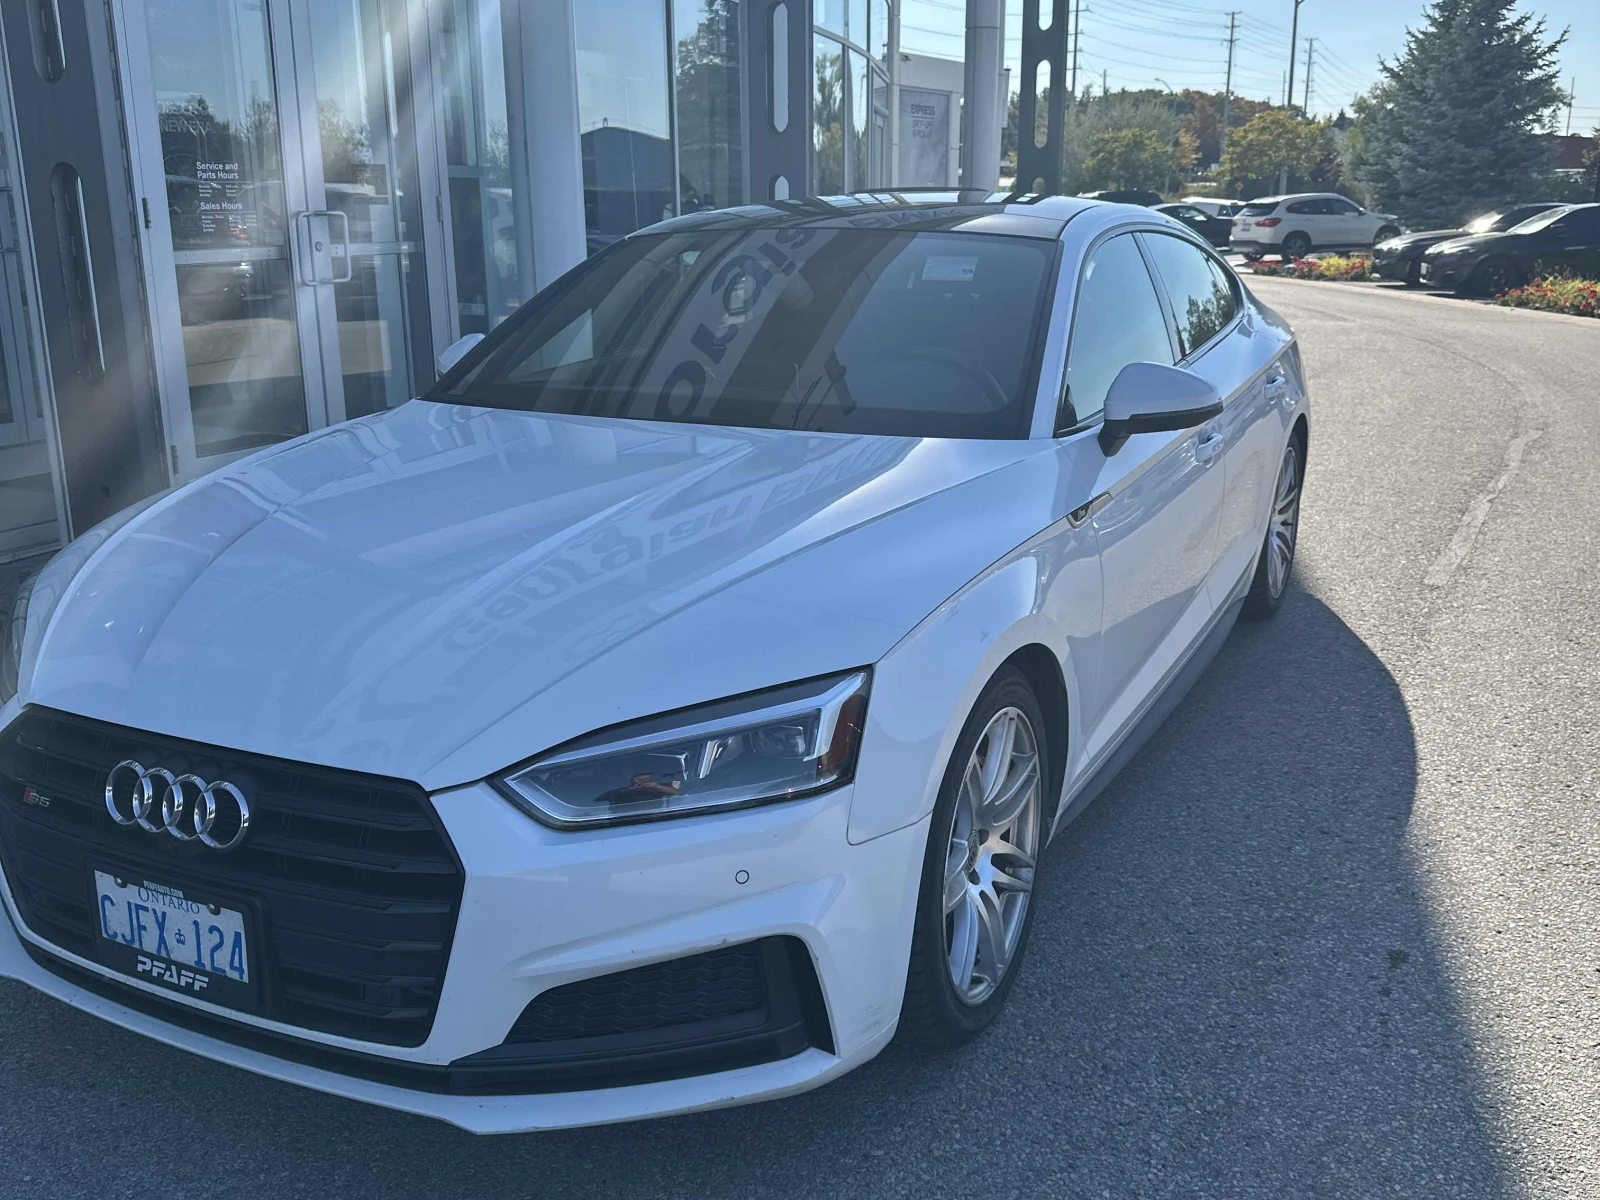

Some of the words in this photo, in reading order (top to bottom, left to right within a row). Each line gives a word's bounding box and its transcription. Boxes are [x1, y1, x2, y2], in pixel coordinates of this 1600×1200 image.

[911, 104, 935, 116] EXPRESS
[160, 119, 187, 133] NEW
[196, 161, 223, 170] Service
[224, 162, 238, 170] and
[197, 171, 216, 179] Parts
[217, 171, 239, 179] Hours
[200, 202, 220, 210] Sales
[221, 202, 243, 210] Hours
[138, 887, 200, 915] ONTARIO
[101, 894, 171, 959] CJFX
[192, 919, 245, 980] 124
[137, 955, 209, 991] PFAFF
